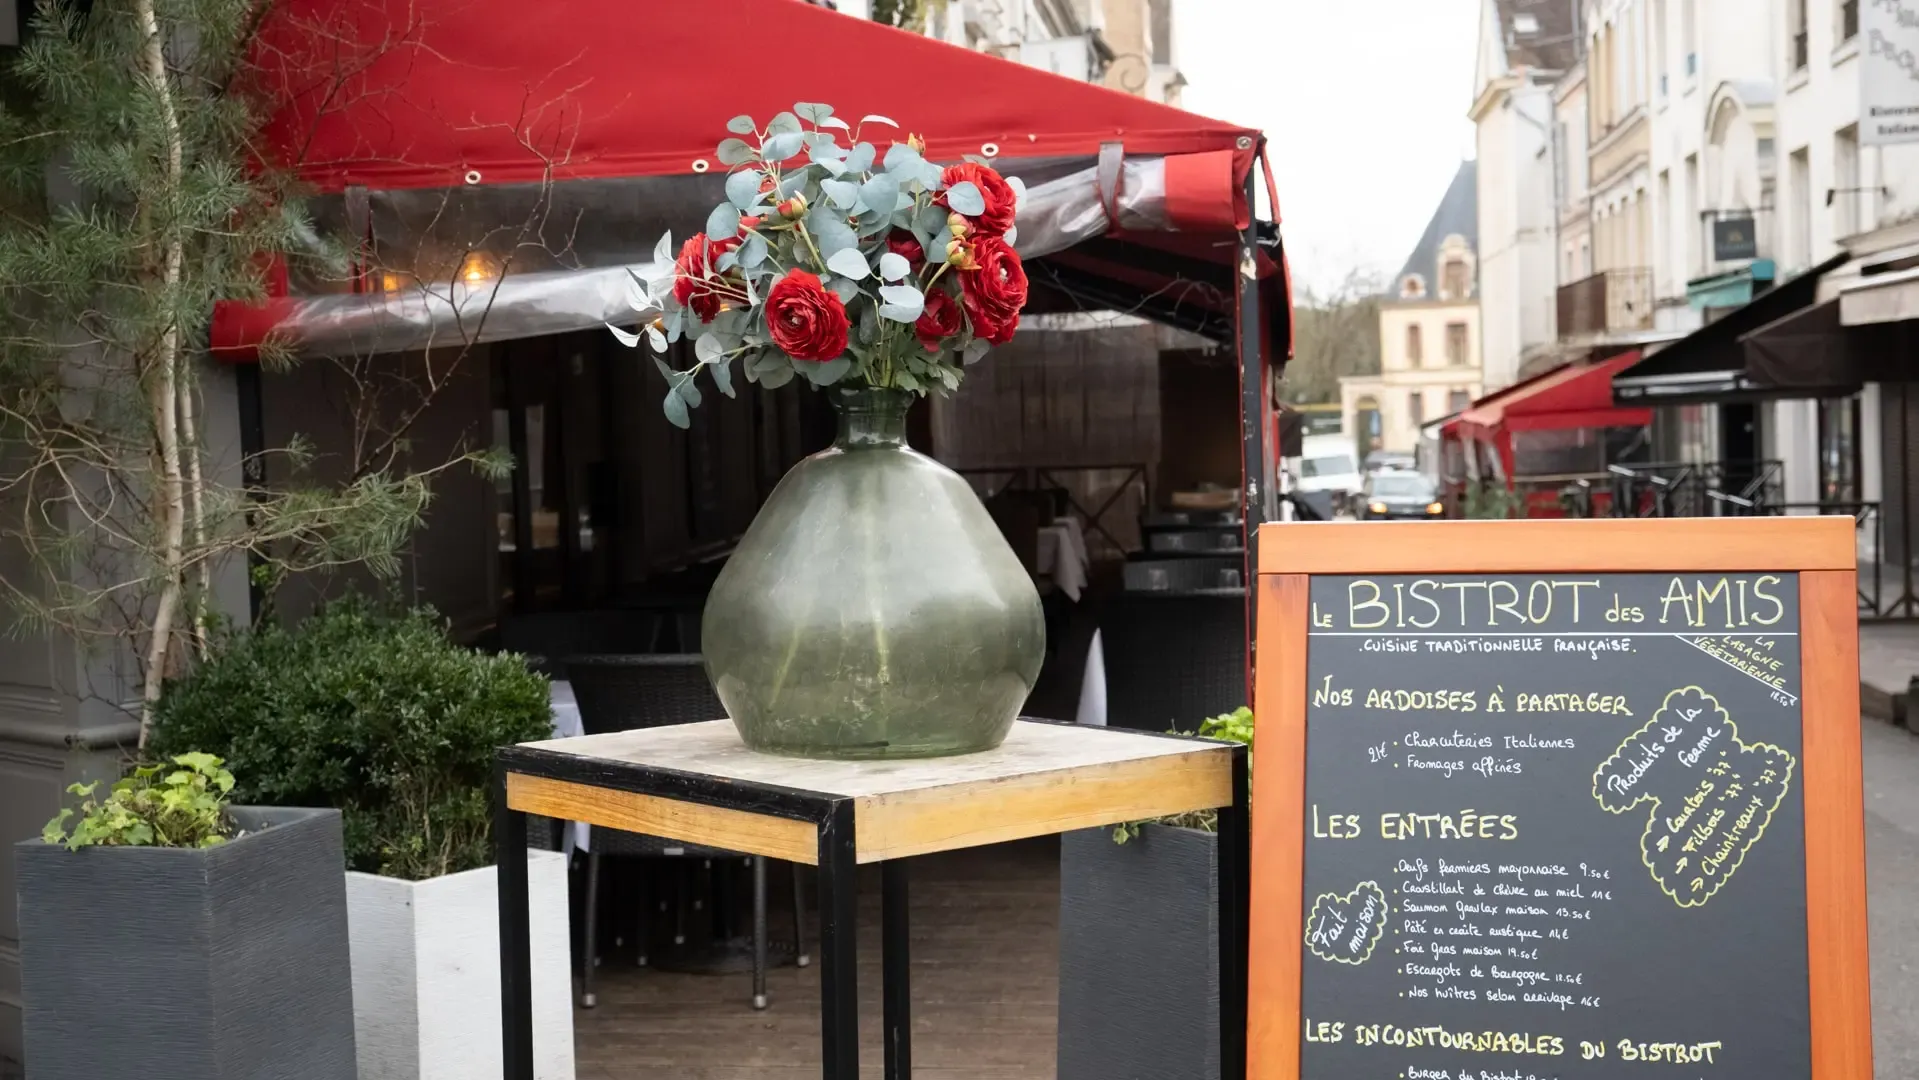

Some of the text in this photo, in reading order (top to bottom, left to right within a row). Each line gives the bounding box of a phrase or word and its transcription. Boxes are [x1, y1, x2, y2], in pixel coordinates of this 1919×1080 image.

[1348, 579, 1600, 628] BISTROT
[1659, 575, 1784, 628] AMIS
[1425, 638, 1543, 653] TRADITIONNELLE
[1722, 635, 1784, 671] LASAGNE
[1754, 636, 1776, 650] LA
[1694, 636, 1787, 689] VÉGÉTARIENNE
[1365, 688, 1477, 713] ARDOISES
[1486, 685, 1506, 713] À
[1516, 692, 1634, 717] PARTAGER
[1404, 730, 1576, 749] Charcuteries Italiennes
[1607, 707, 1702, 795] Produits de la
[1407, 754, 1522, 778] Fromages affinés
[1666, 780, 1715, 833] Courtois
[1381, 809, 1518, 840] ENTRÉES
[1702, 795, 1763, 876] Chaintreaux
[1438, 859, 1491, 876] fermiers
[1499, 863, 1569, 881] mayonnaise
[1473, 883, 1486, 896] de
[1534, 889, 1549, 897] au
[1556, 884, 1584, 898] miel
[1403, 898, 1448, 913] Saumon
[1505, 904, 1549, 915] maison
[1311, 905, 1348, 948] Fait
[1349, 894, 1379, 953] maison
[1404, 919, 1428, 935] Pâté
[1433, 927, 1445, 935] en
[1489, 924, 1543, 942] rustique
[1403, 940, 1425, 953] Foie
[1462, 945, 1502, 956] maison
[1406, 963, 1461, 984] Escargots
[1470, 965, 1485, 978] de
[1491, 965, 1550, 986] Bourgogne
[1408, 985, 1429, 998] Nos
[1435, 986, 1477, 1000] huîtres
[1486, 988, 1517, 1002] selon
[1523, 991, 1576, 1011] arrivage
[1305, 1019, 1722, 1065] LES INCONTOURNABLES DU BISTROT
